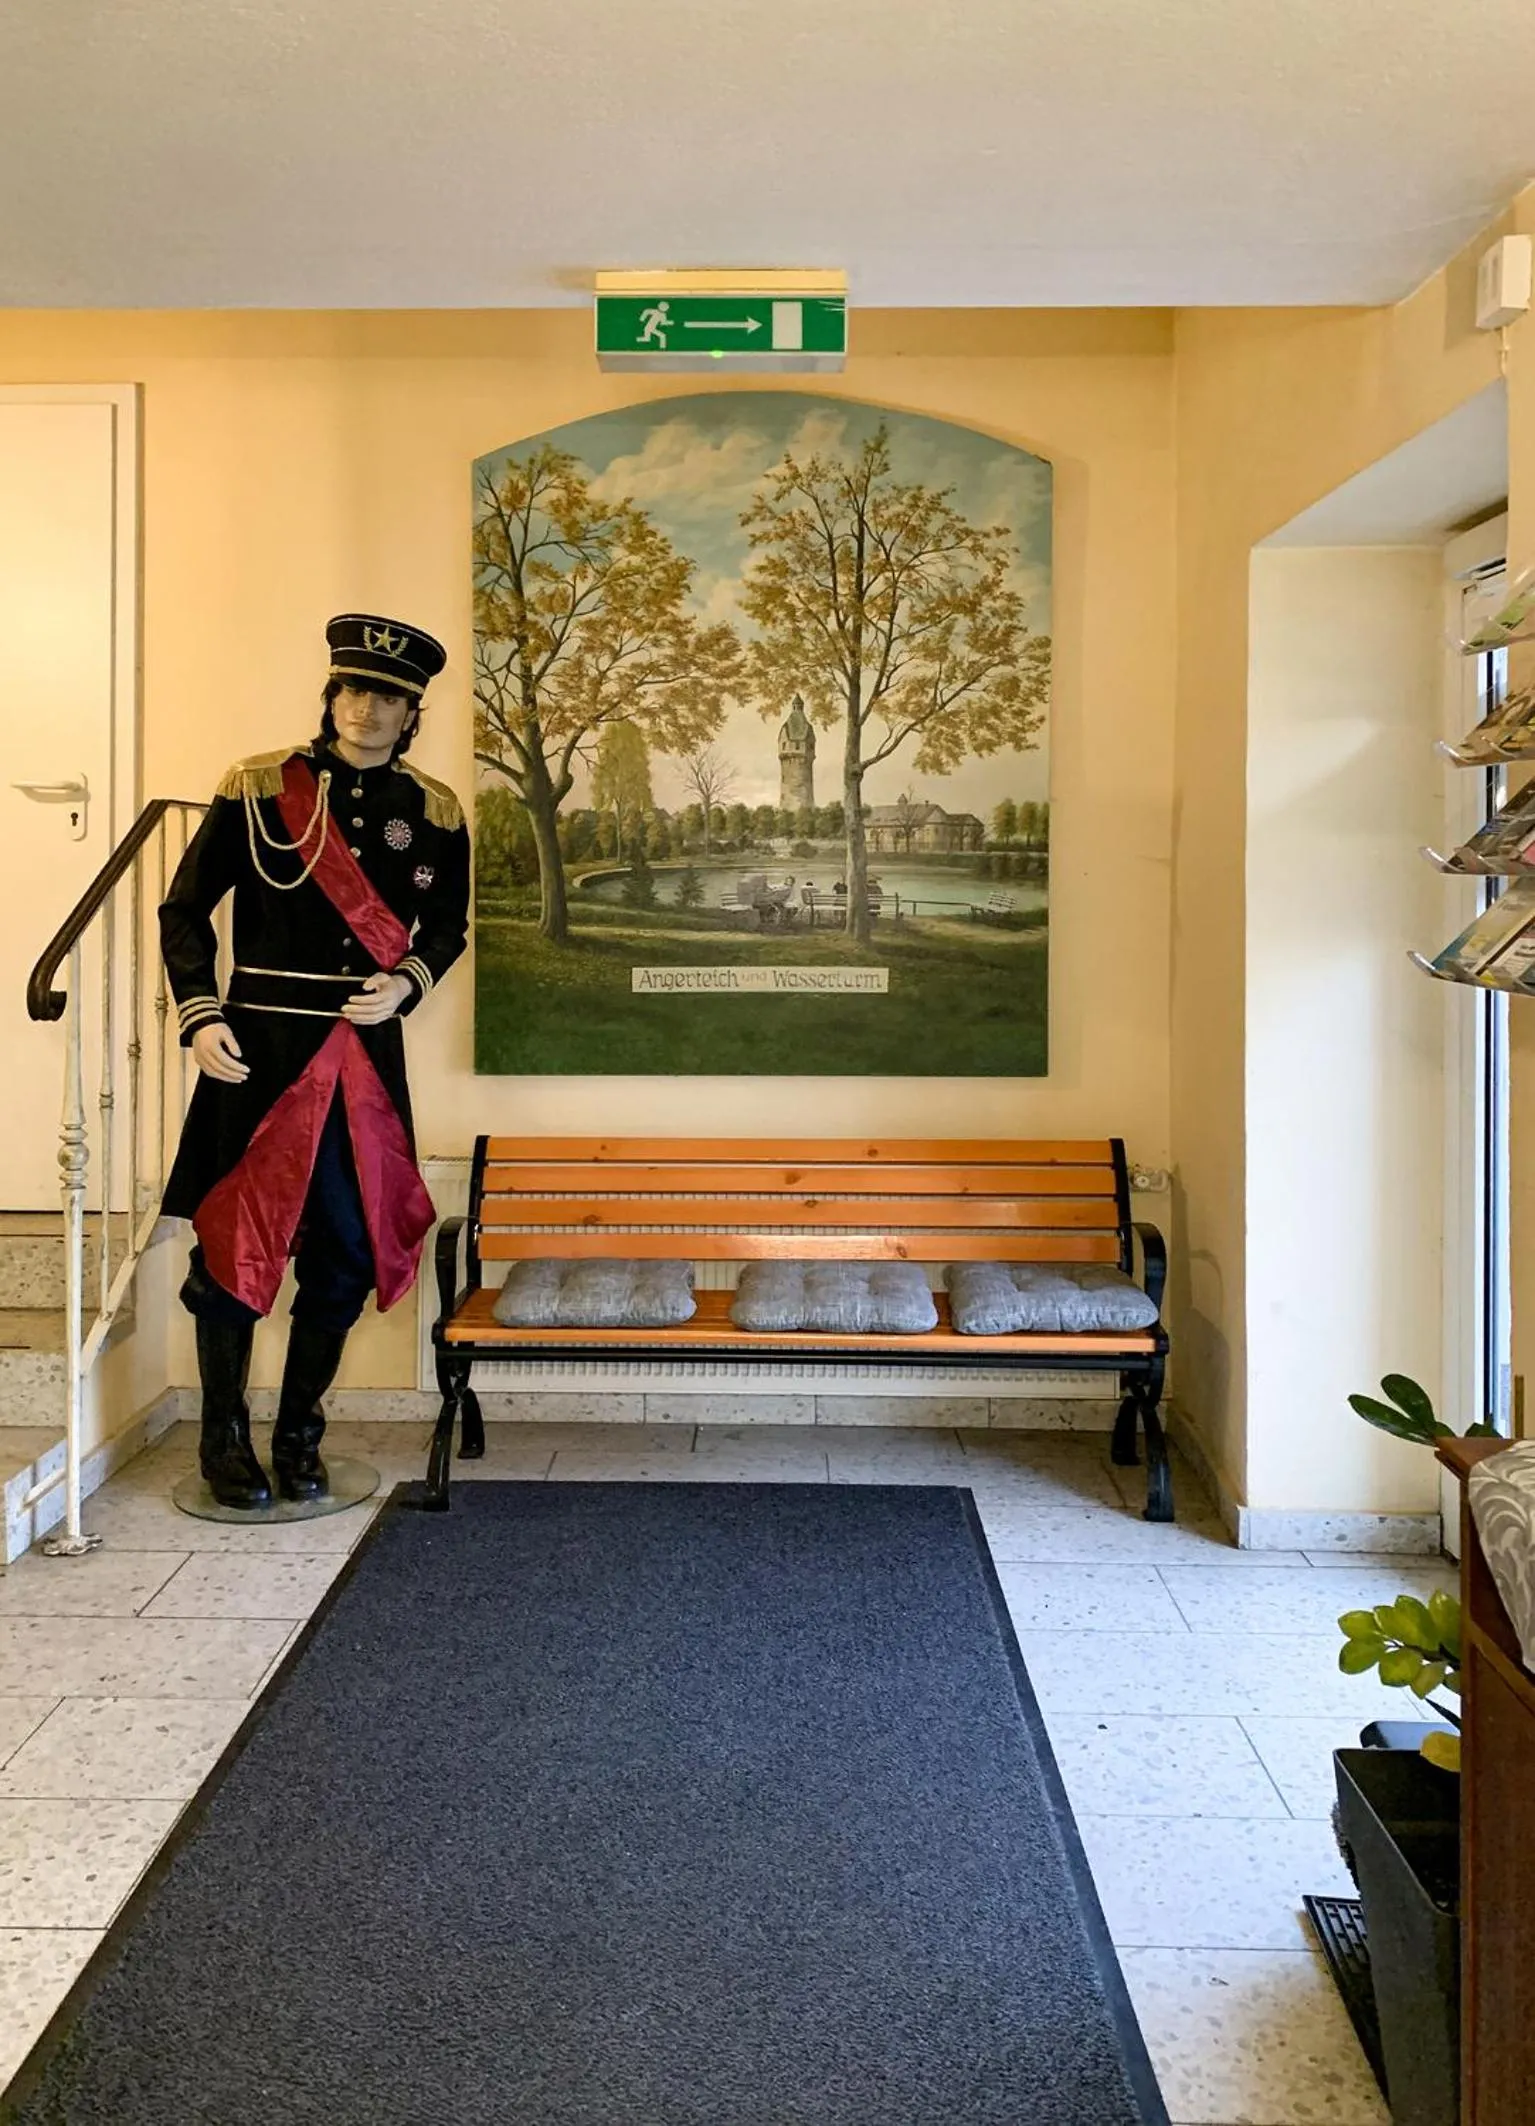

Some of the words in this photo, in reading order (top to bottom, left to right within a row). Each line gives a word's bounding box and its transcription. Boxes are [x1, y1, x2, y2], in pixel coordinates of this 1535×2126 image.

[638, 969, 740, 990] Angerteich
[741, 971, 767, 983] und
[772, 969, 883, 989] Wasserturm
